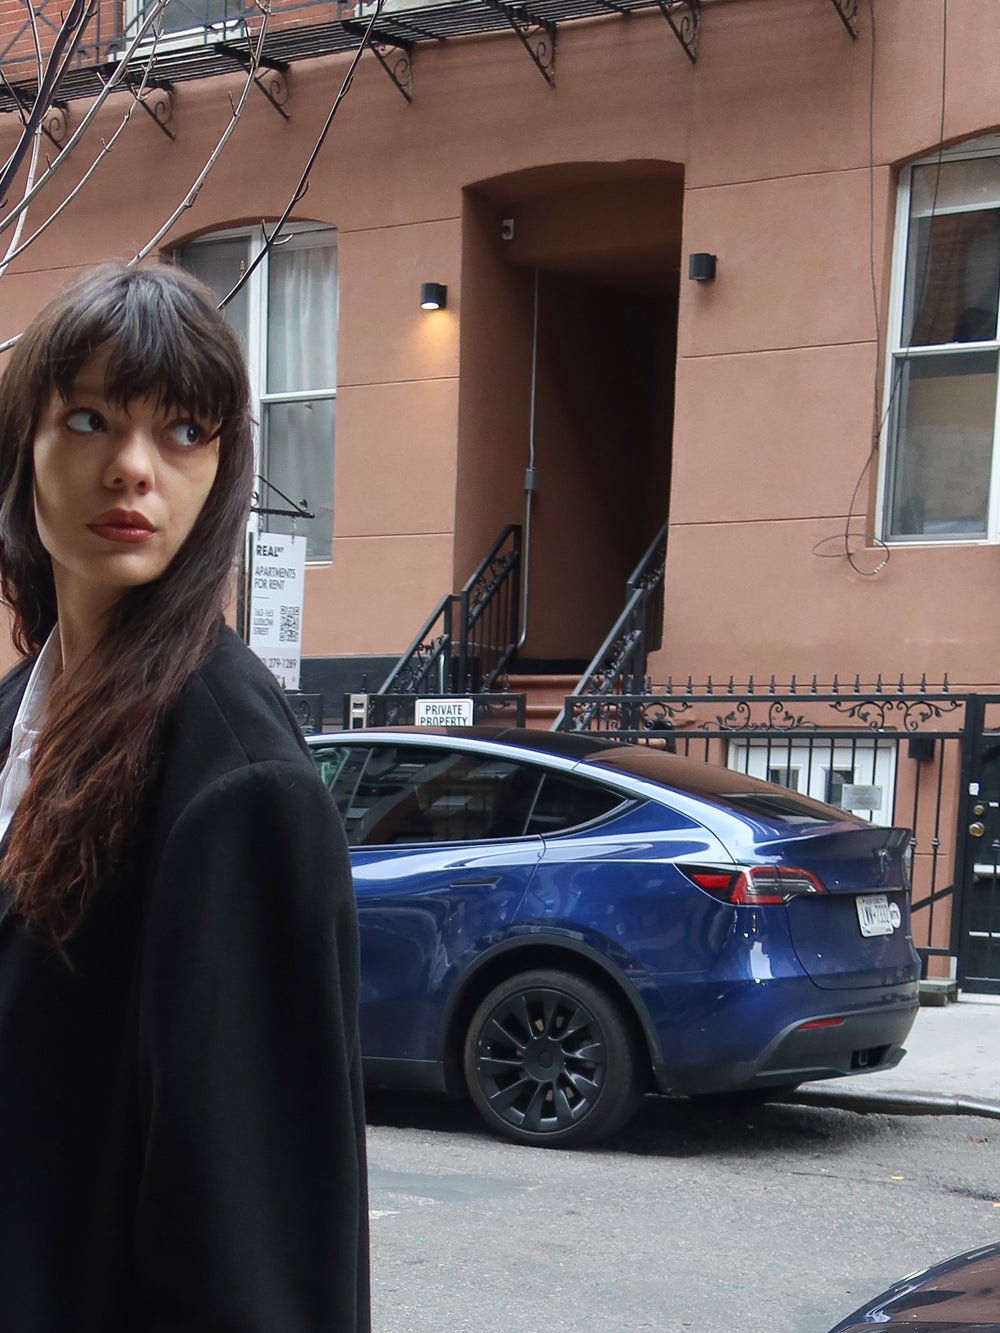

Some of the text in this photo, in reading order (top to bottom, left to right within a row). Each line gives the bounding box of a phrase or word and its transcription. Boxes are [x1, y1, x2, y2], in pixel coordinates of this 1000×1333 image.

[255, 566, 296, 579] APARTMENTS
[255, 578, 285, 590] FOR RENT
[253, 627, 269, 635] STREET
[425, 705, 463, 715] PRIVATE
[420, 717, 468, 726] PROPERTY
